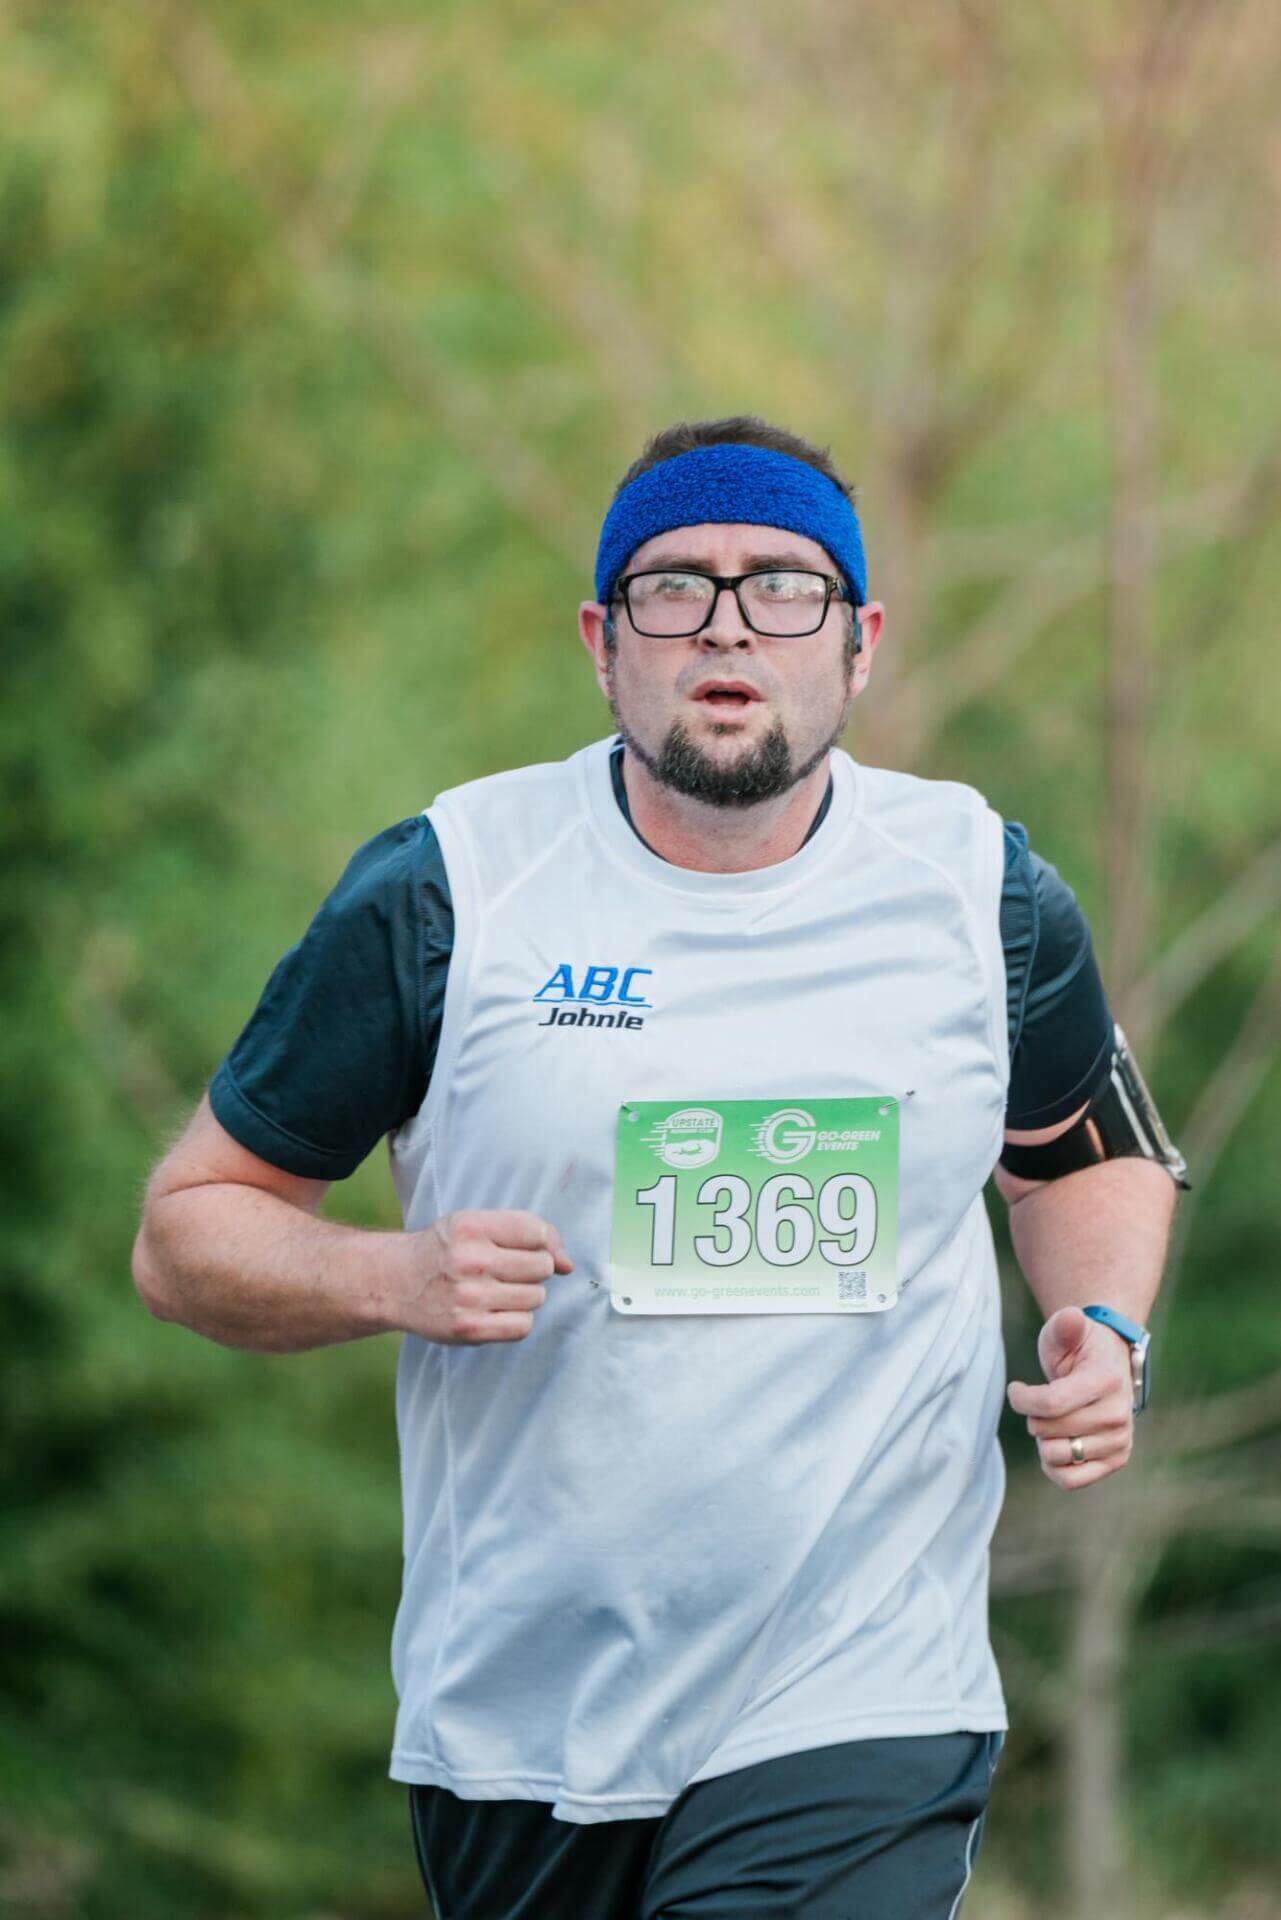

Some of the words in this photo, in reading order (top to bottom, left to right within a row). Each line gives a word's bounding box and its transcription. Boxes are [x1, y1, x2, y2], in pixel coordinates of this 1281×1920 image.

[534, 963, 653, 1002] ABC
[538, 1007, 644, 1030] Johnie
[672, 1117, 716, 1128] UPSTATE
[816, 1130, 881, 1142] GO-GREEN
[816, 1141, 859, 1151] EVENTS
[635, 1172, 878, 1267] 1369
